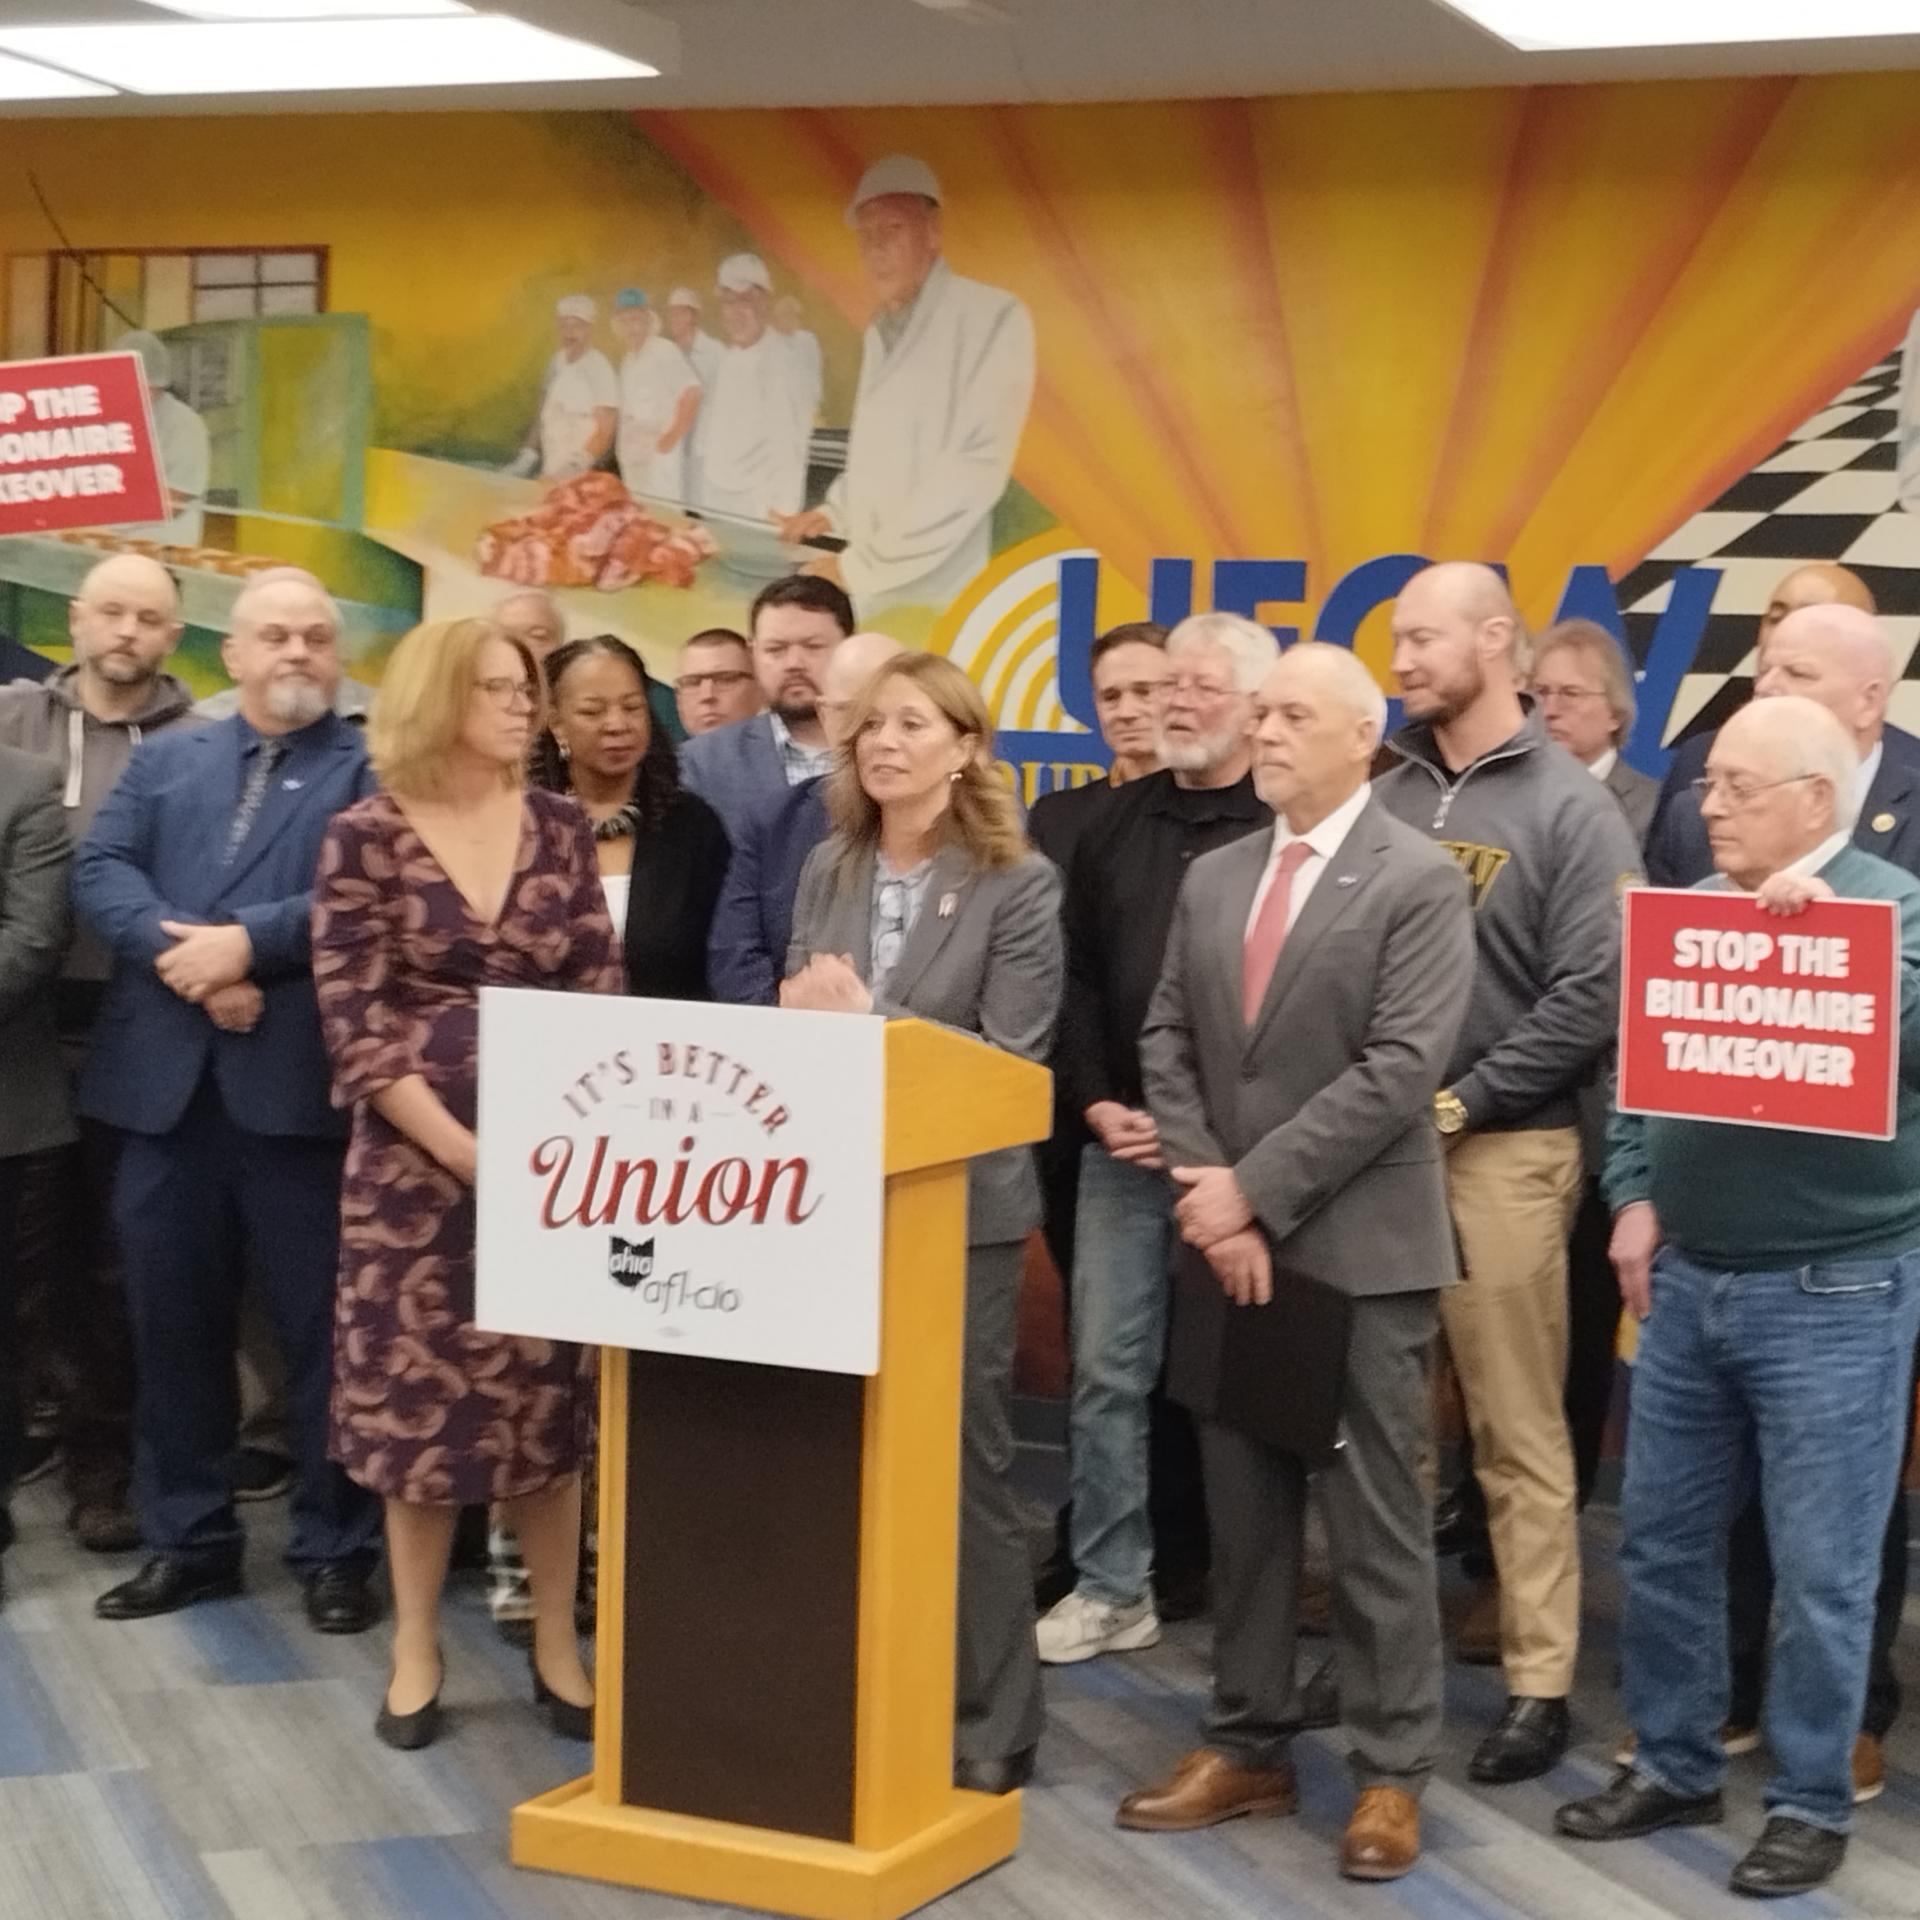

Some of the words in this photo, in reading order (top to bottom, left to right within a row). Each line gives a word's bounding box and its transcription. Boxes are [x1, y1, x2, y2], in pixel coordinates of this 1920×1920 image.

[26, 384, 102, 421] THE
[1673, 928, 1774, 972] STOP
[1777, 934, 1850, 979] THE
[1645, 978, 1876, 1035] BILLIONAIRE
[1662, 1031, 1855, 1087] TAKEOVER
[562, 1049, 637, 1119] IT'S
[657, 1042, 791, 1137] BETTER
[649, 1098, 673, 1121] IN
[688, 1102, 704, 1124] A
[529, 1133, 826, 1231] Union
[642, 1269, 743, 1315] afl-cio
